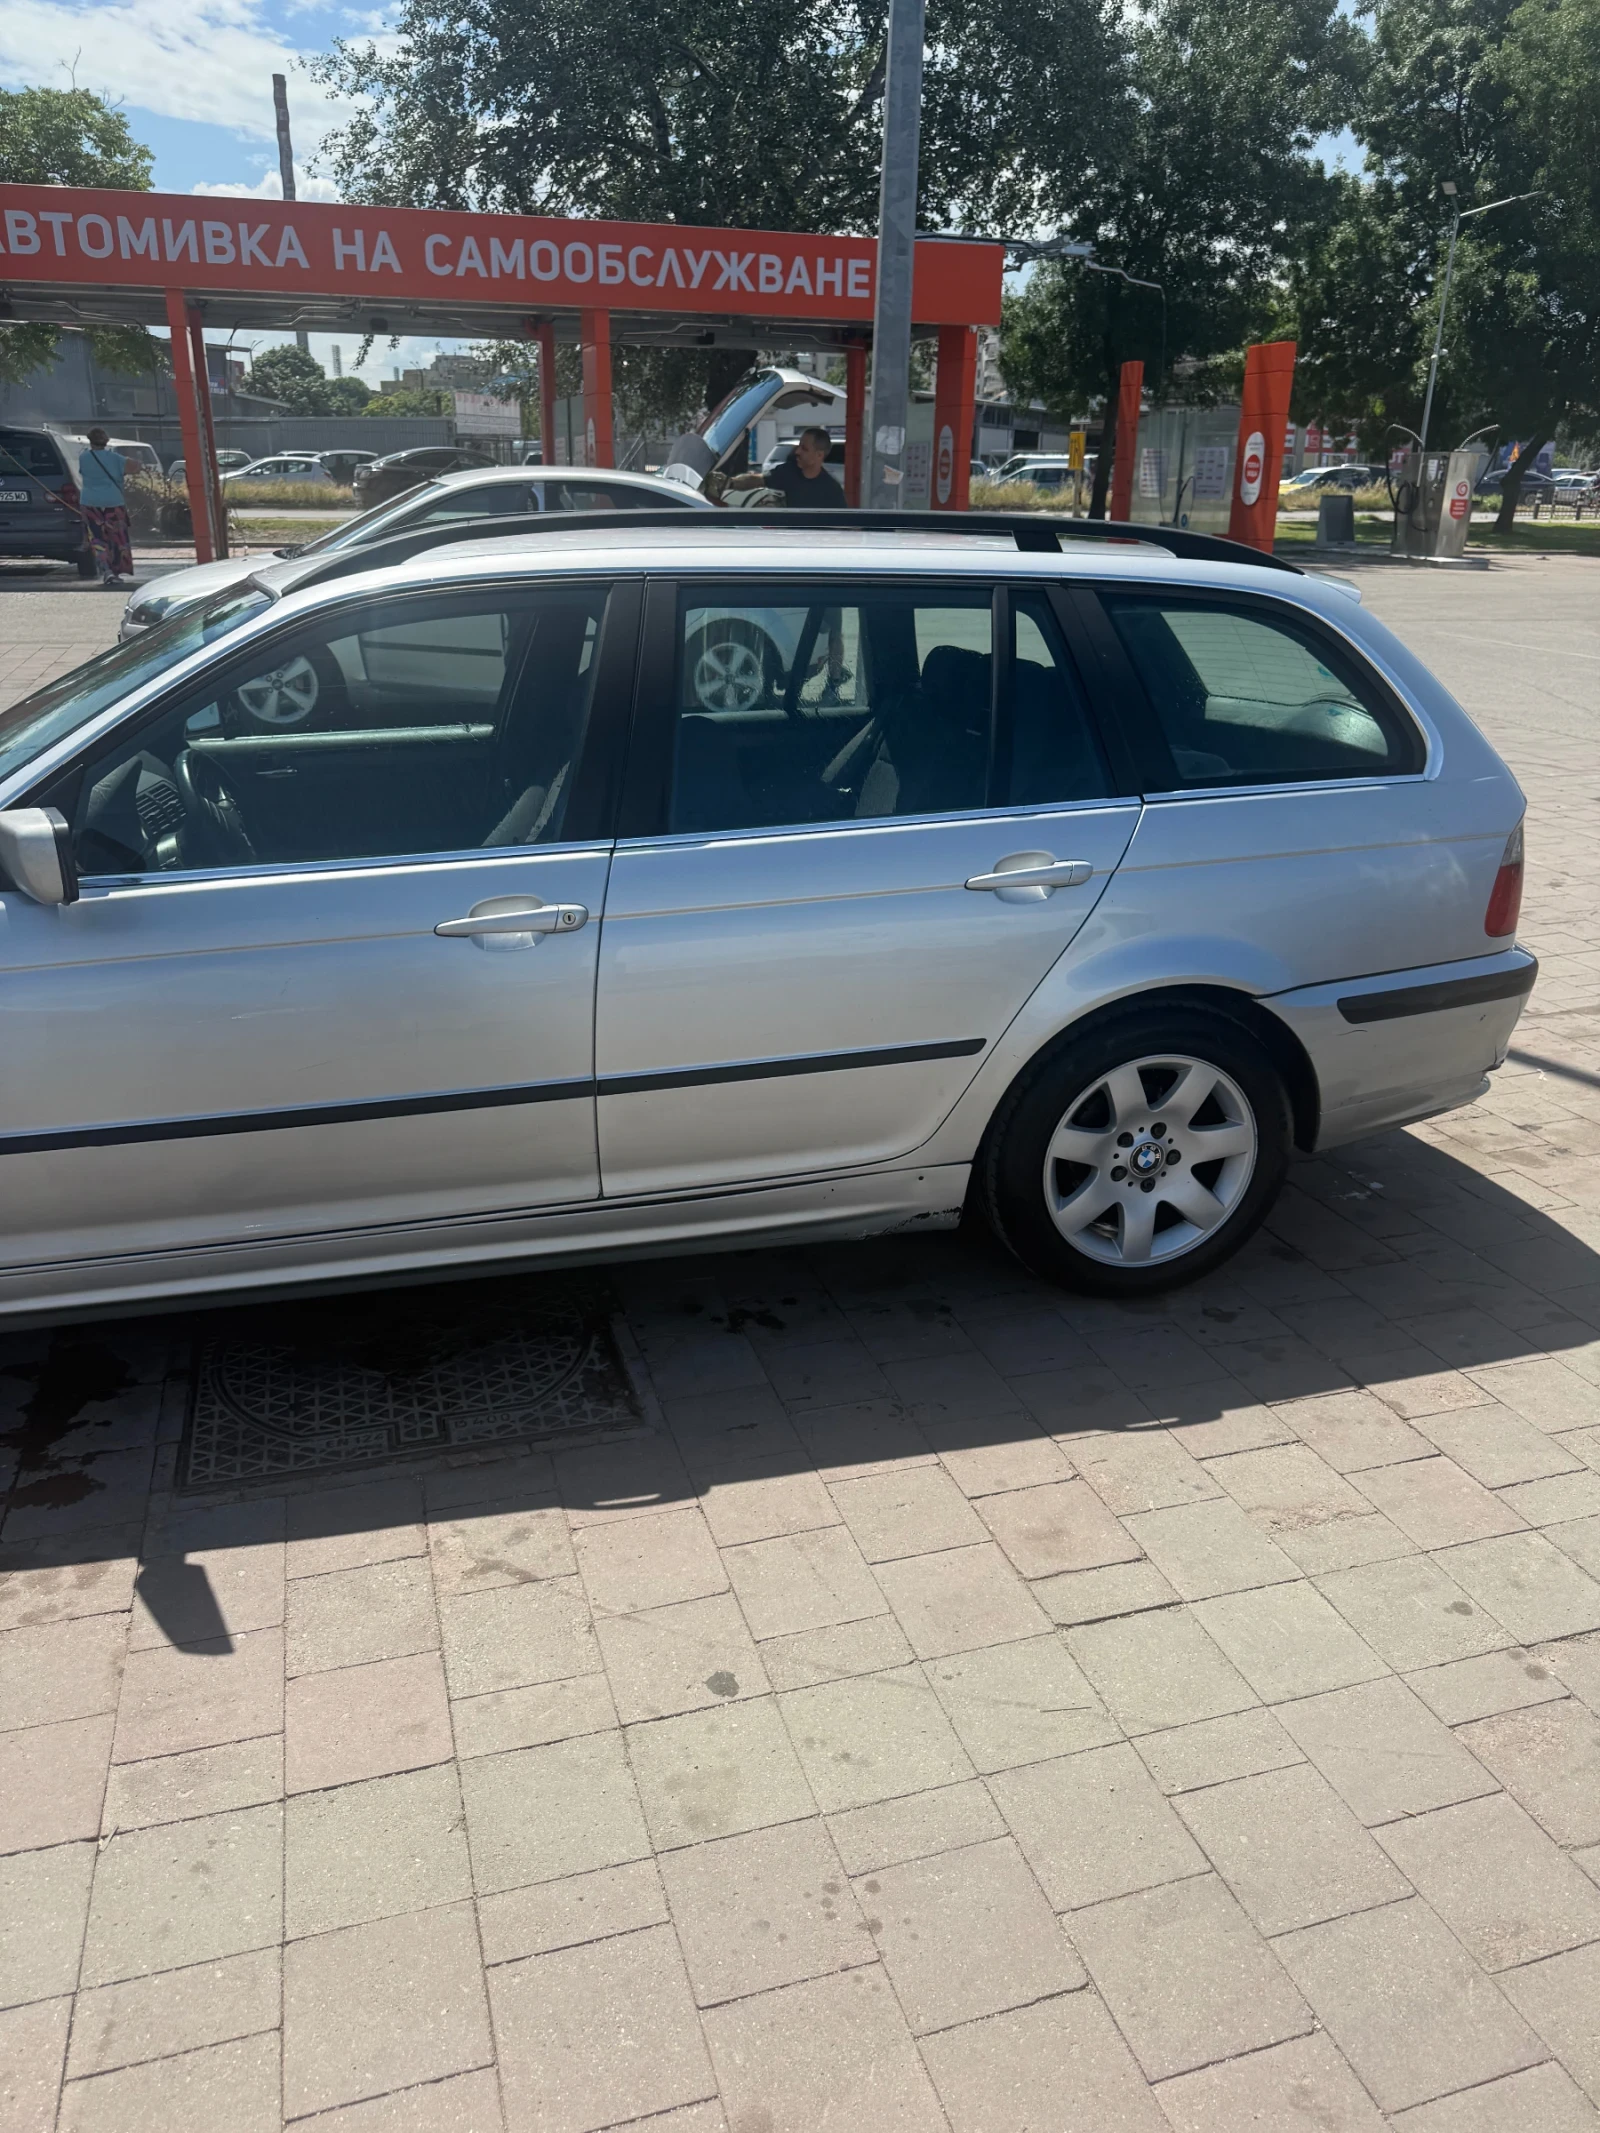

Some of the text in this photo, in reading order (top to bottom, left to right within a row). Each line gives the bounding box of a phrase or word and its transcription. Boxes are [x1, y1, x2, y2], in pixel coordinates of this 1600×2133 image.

[0, 209, 871, 298] ВТОМИВКА НА САМООБСЛУЖВАНЕ
[1141, 1145, 1161, 1159] BMW
